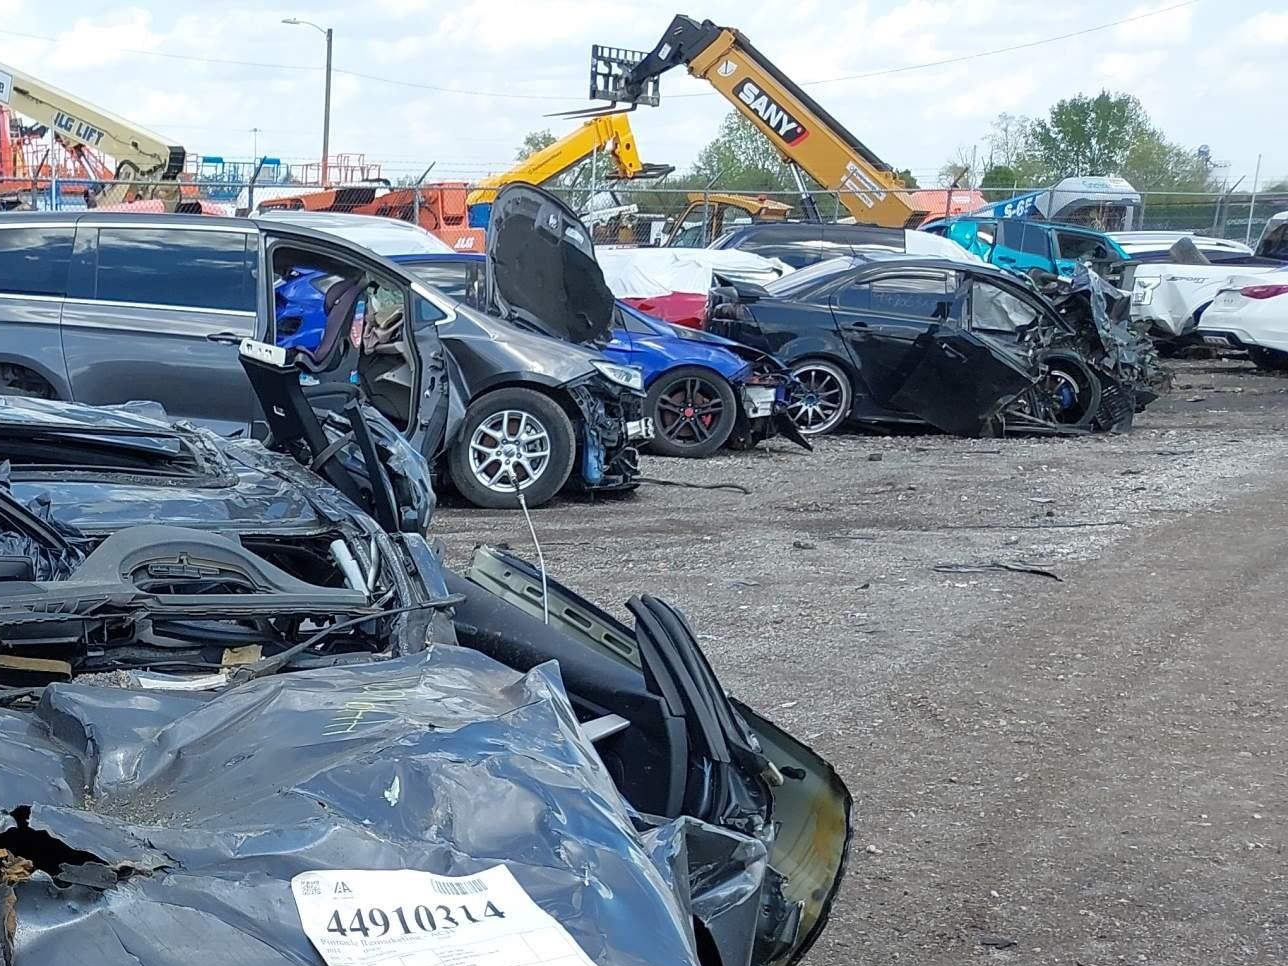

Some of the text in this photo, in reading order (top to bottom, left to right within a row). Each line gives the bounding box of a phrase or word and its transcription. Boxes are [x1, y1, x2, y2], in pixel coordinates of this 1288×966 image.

[739, 82, 798, 137] SANY
[76, 122, 105, 146] LIFT
[327, 901, 506, 937] 44910314
